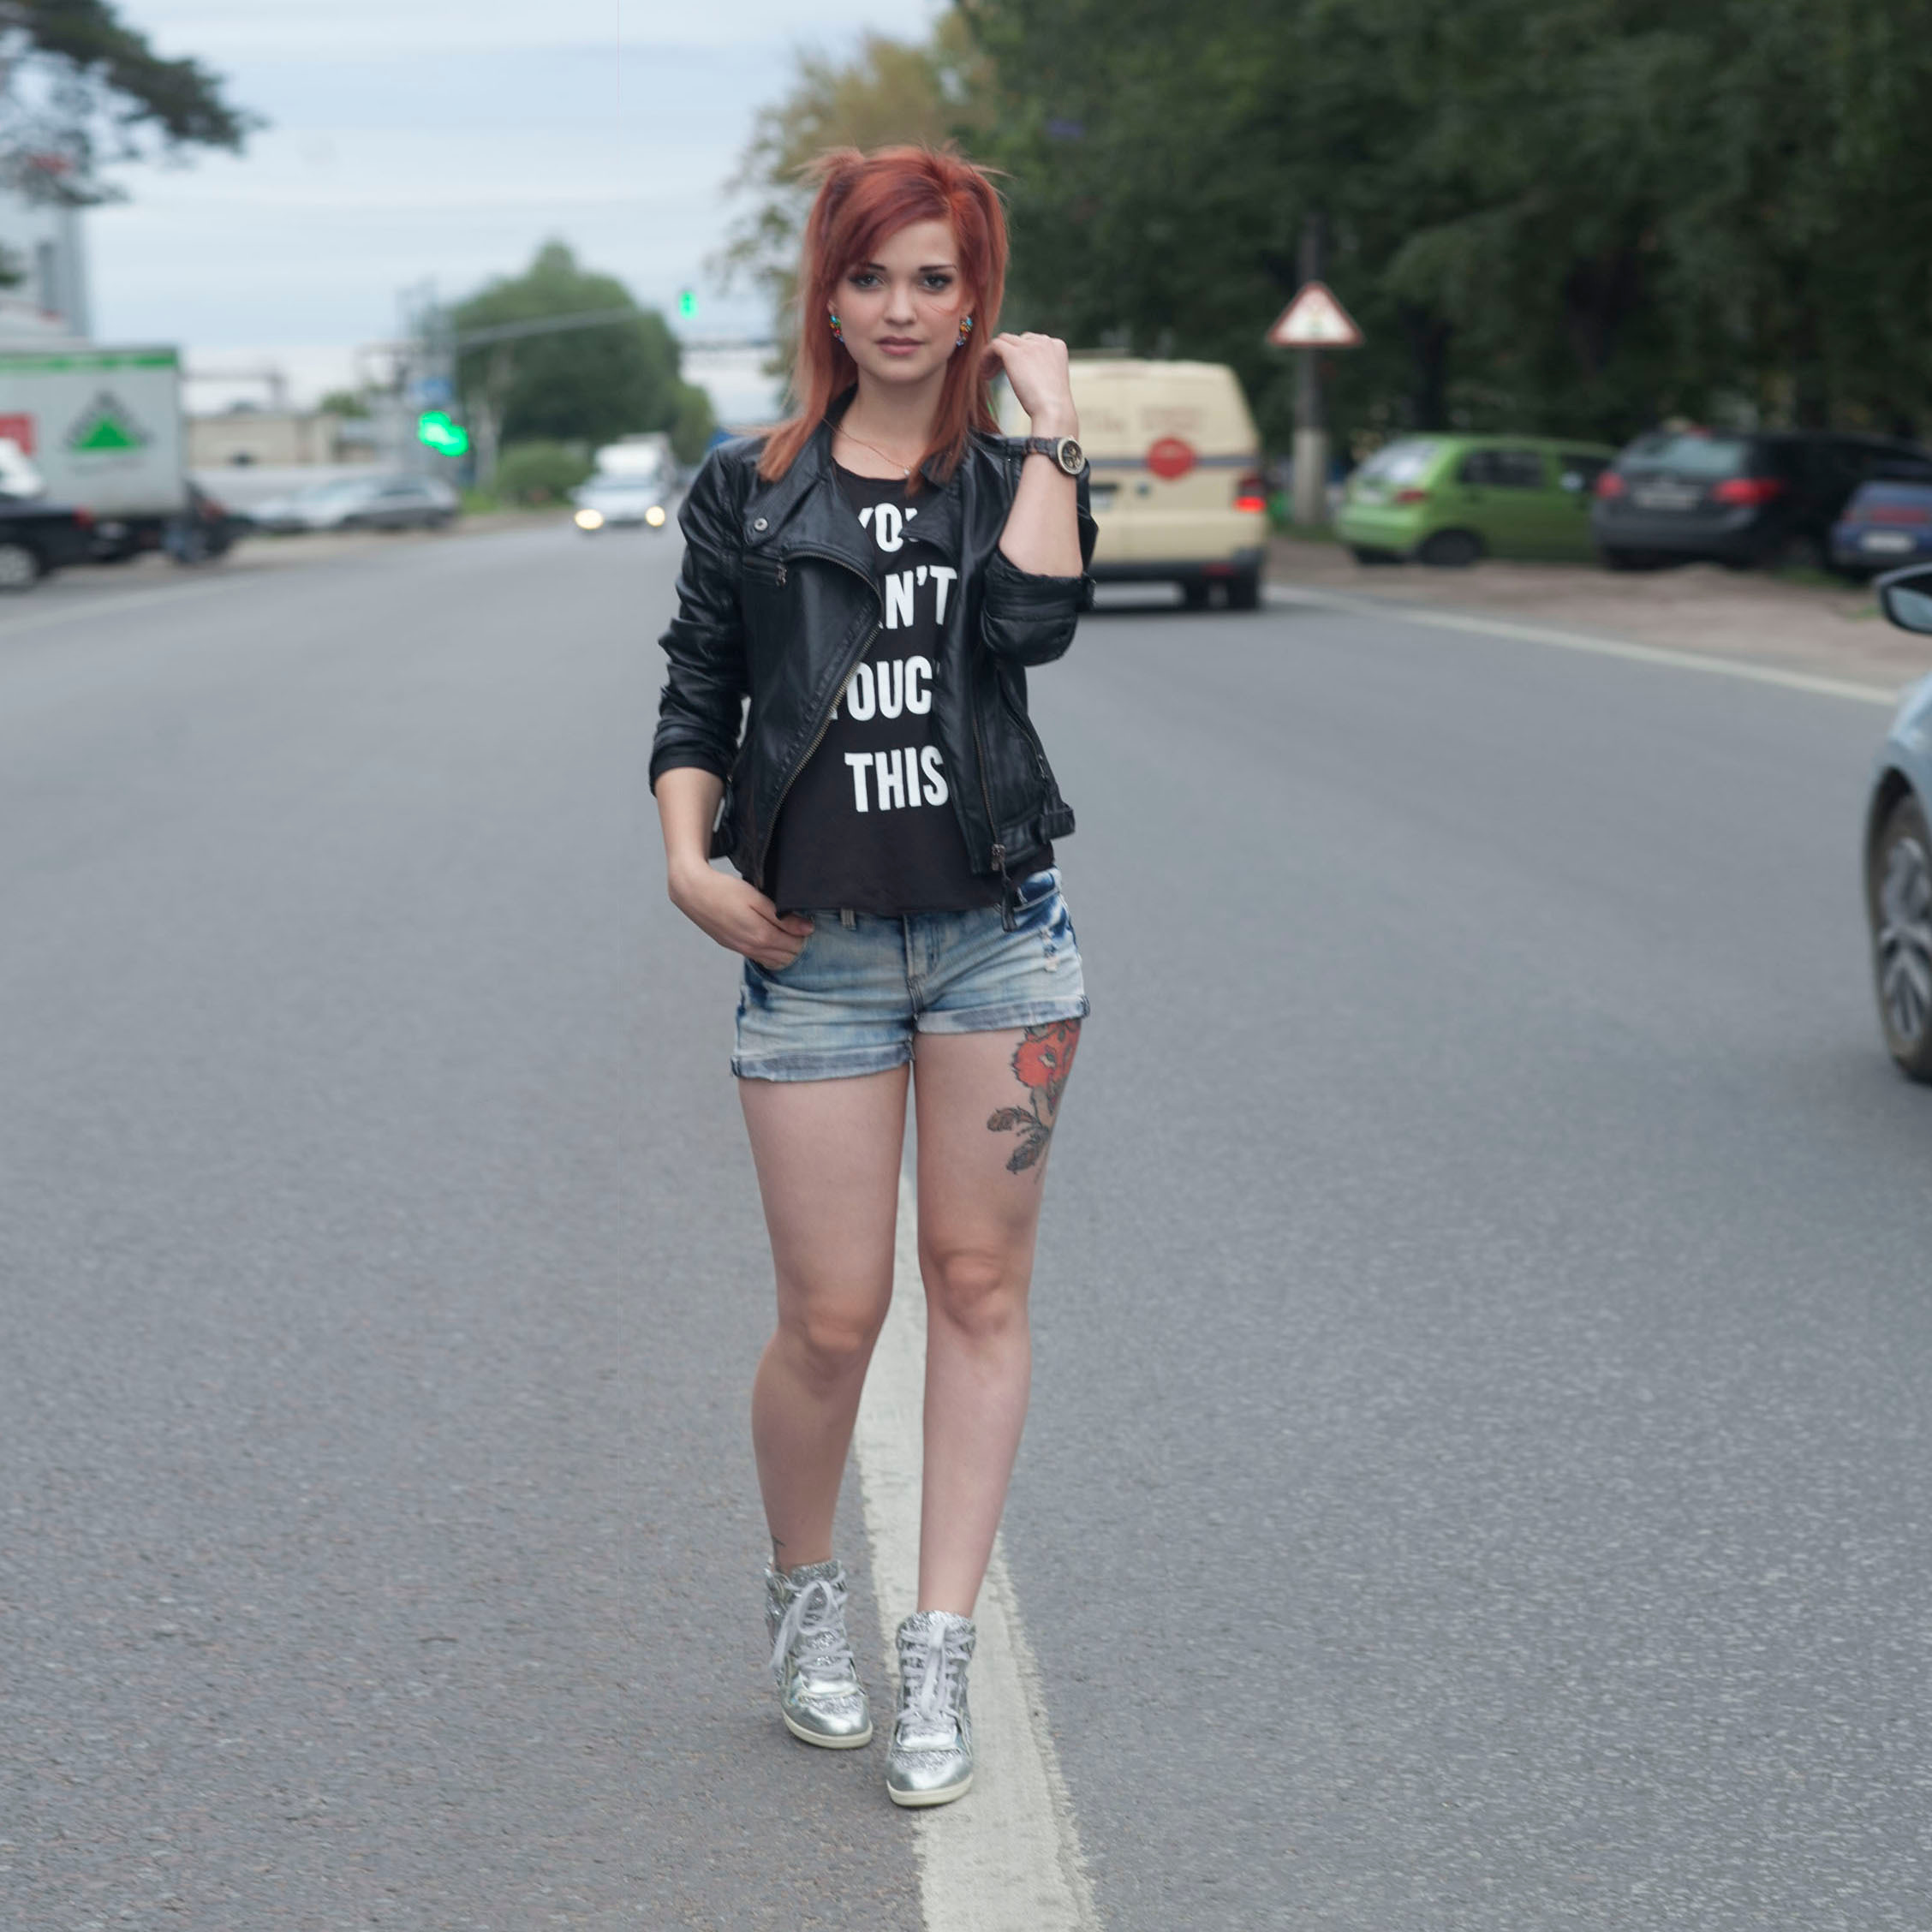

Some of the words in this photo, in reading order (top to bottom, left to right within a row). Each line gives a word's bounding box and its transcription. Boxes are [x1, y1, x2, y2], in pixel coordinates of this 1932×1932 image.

[878, 564, 957, 629] N'T
[830, 655, 939, 721] OUC
[844, 745, 949, 813] THIS
